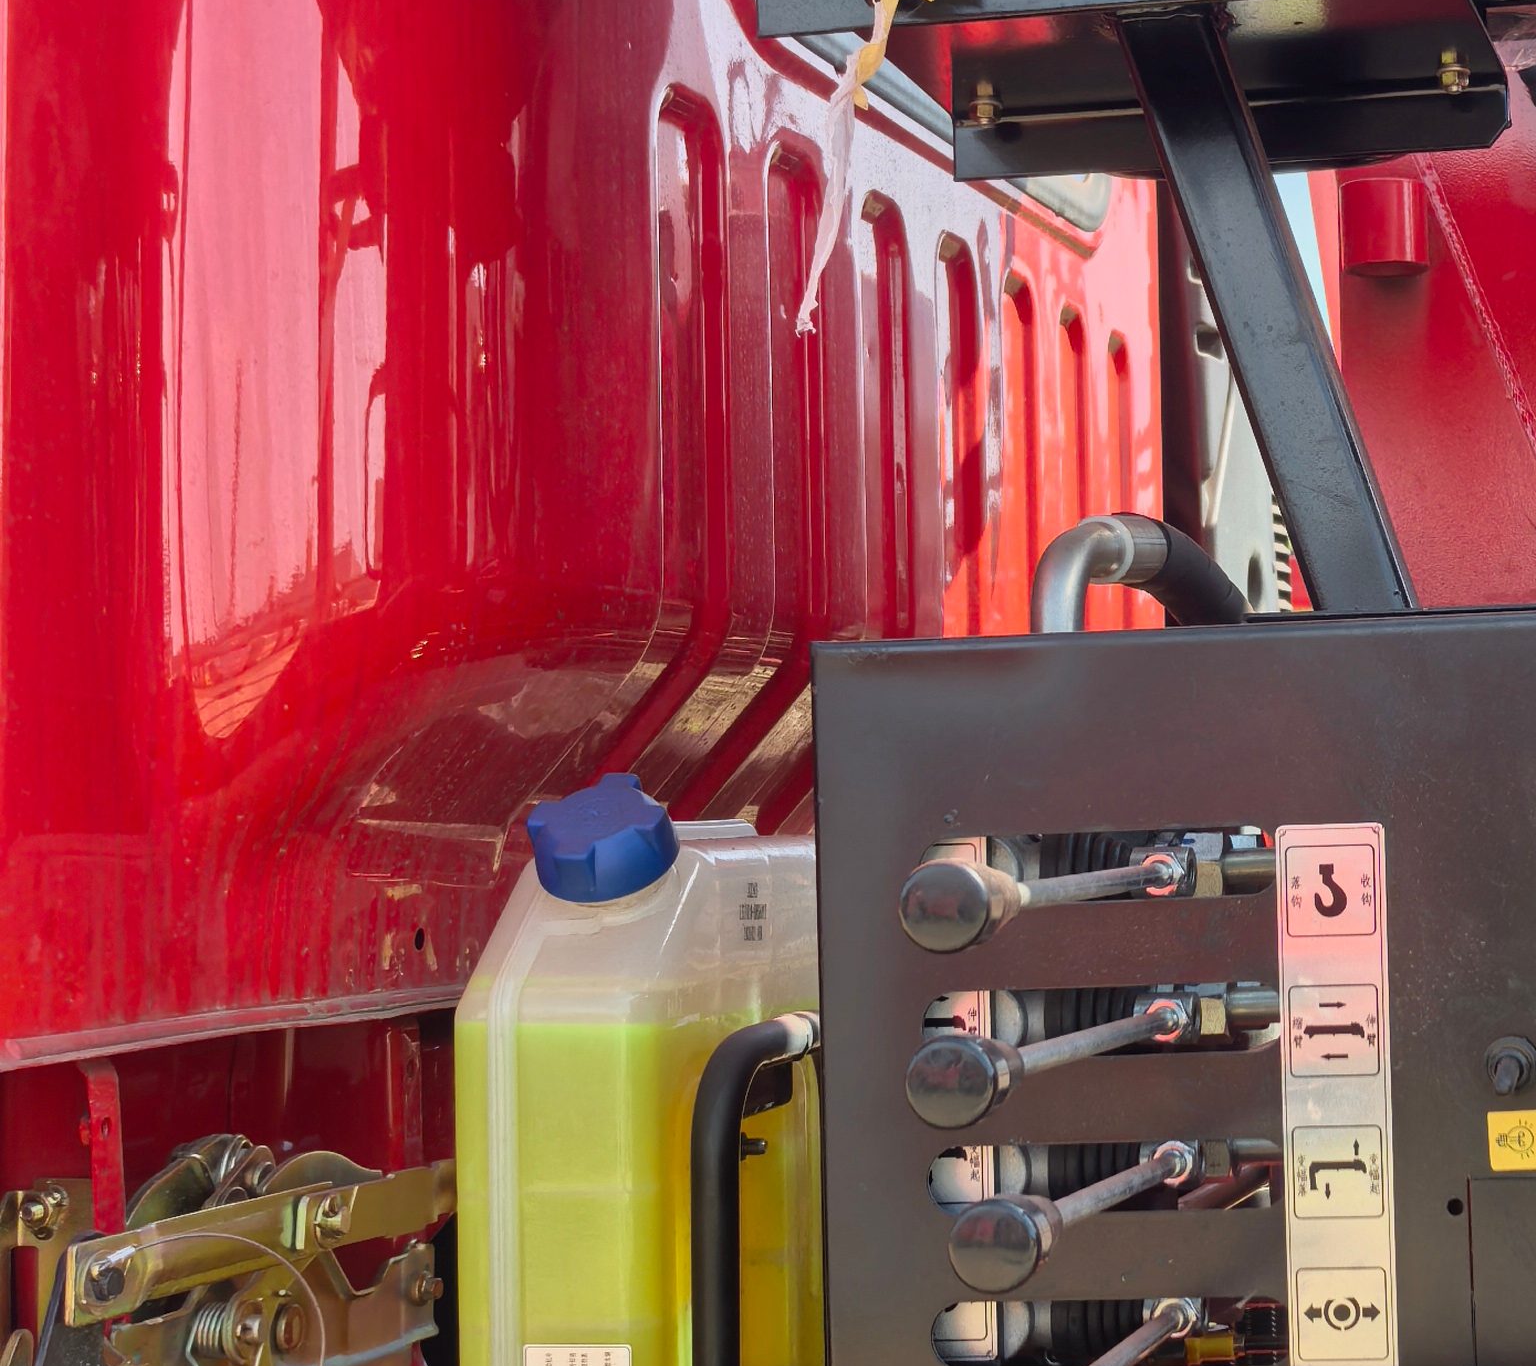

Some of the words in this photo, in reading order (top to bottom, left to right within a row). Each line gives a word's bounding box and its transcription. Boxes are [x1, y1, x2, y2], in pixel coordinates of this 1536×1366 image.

[1291, 876, 1302, 909] 落钩
[1360, 873, 1372, 907] 收钩
[1366, 1013, 1377, 1047] 伸臂
